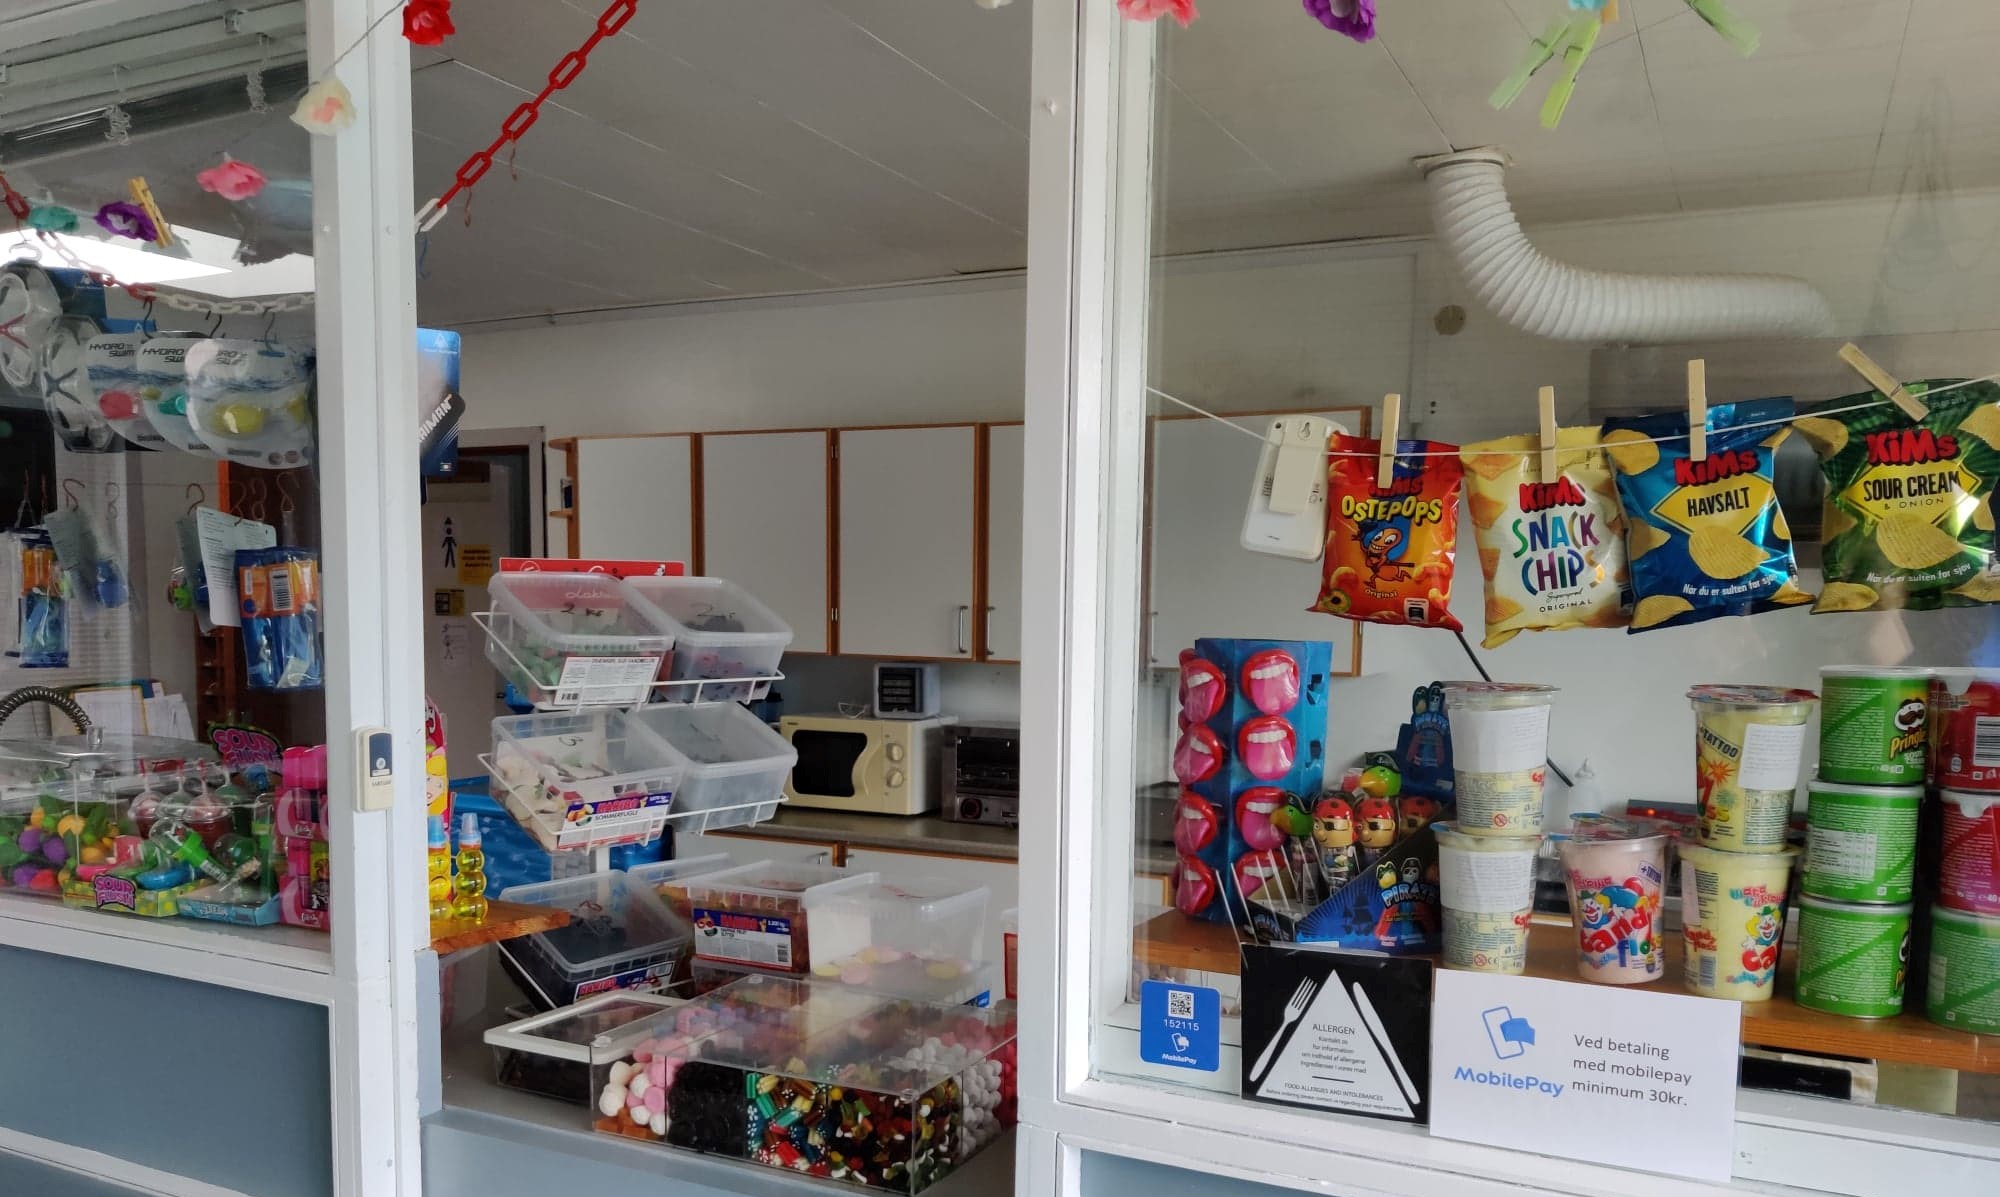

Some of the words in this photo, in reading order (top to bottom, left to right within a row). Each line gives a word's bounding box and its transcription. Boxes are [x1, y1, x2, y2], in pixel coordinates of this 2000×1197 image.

[164, 354, 185, 363] SWI
[1863, 477, 1904, 502] SOUR
[1687, 486, 1750, 518] HAVSALT
[1899, 496, 1944, 509] ONION
[1511, 510, 1600, 559] SNACK
[1521, 548, 1606, 597] CHIPS
[1722, 583, 1748, 596] sulten
[1539, 600, 1593, 613] ORIGINAL
[1163, 1019, 1200, 1031] 152115
[1312, 1023, 1355, 1035] ALLERGEN
[1574, 1034, 1603, 1050] Ved
[1607, 1037, 1670, 1061] betaling
[1162, 1053, 1198, 1065] MobilePay
[1573, 1058, 1606, 1073] med
[1611, 1062, 1692, 1086] mobilepay
[1284, 1082, 1300, 1090] FOOD
[1453, 1066, 1565, 1098] MobilePay
[1571, 1079, 1644, 1100] minimum
[1648, 1089, 1689, 1107] 30kr.
